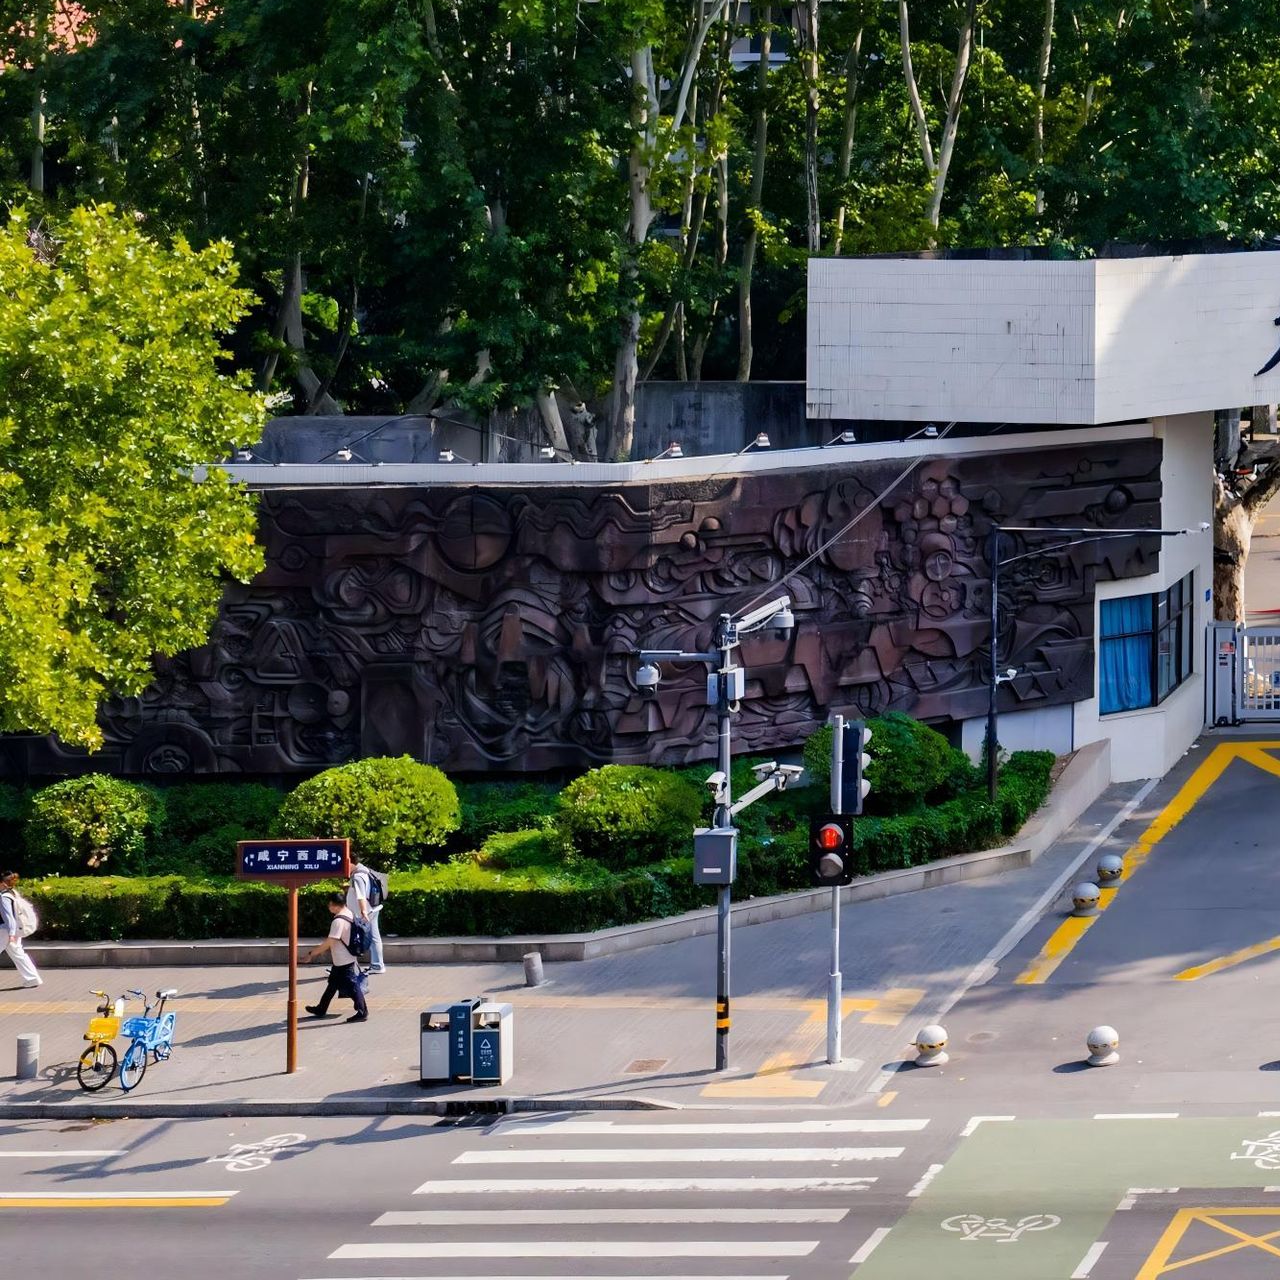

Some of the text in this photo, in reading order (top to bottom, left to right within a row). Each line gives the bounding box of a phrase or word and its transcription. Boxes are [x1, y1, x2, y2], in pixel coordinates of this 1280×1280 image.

[257, 849, 329, 862] 咸宁西路
[266, 863, 299, 871] XIANNING
